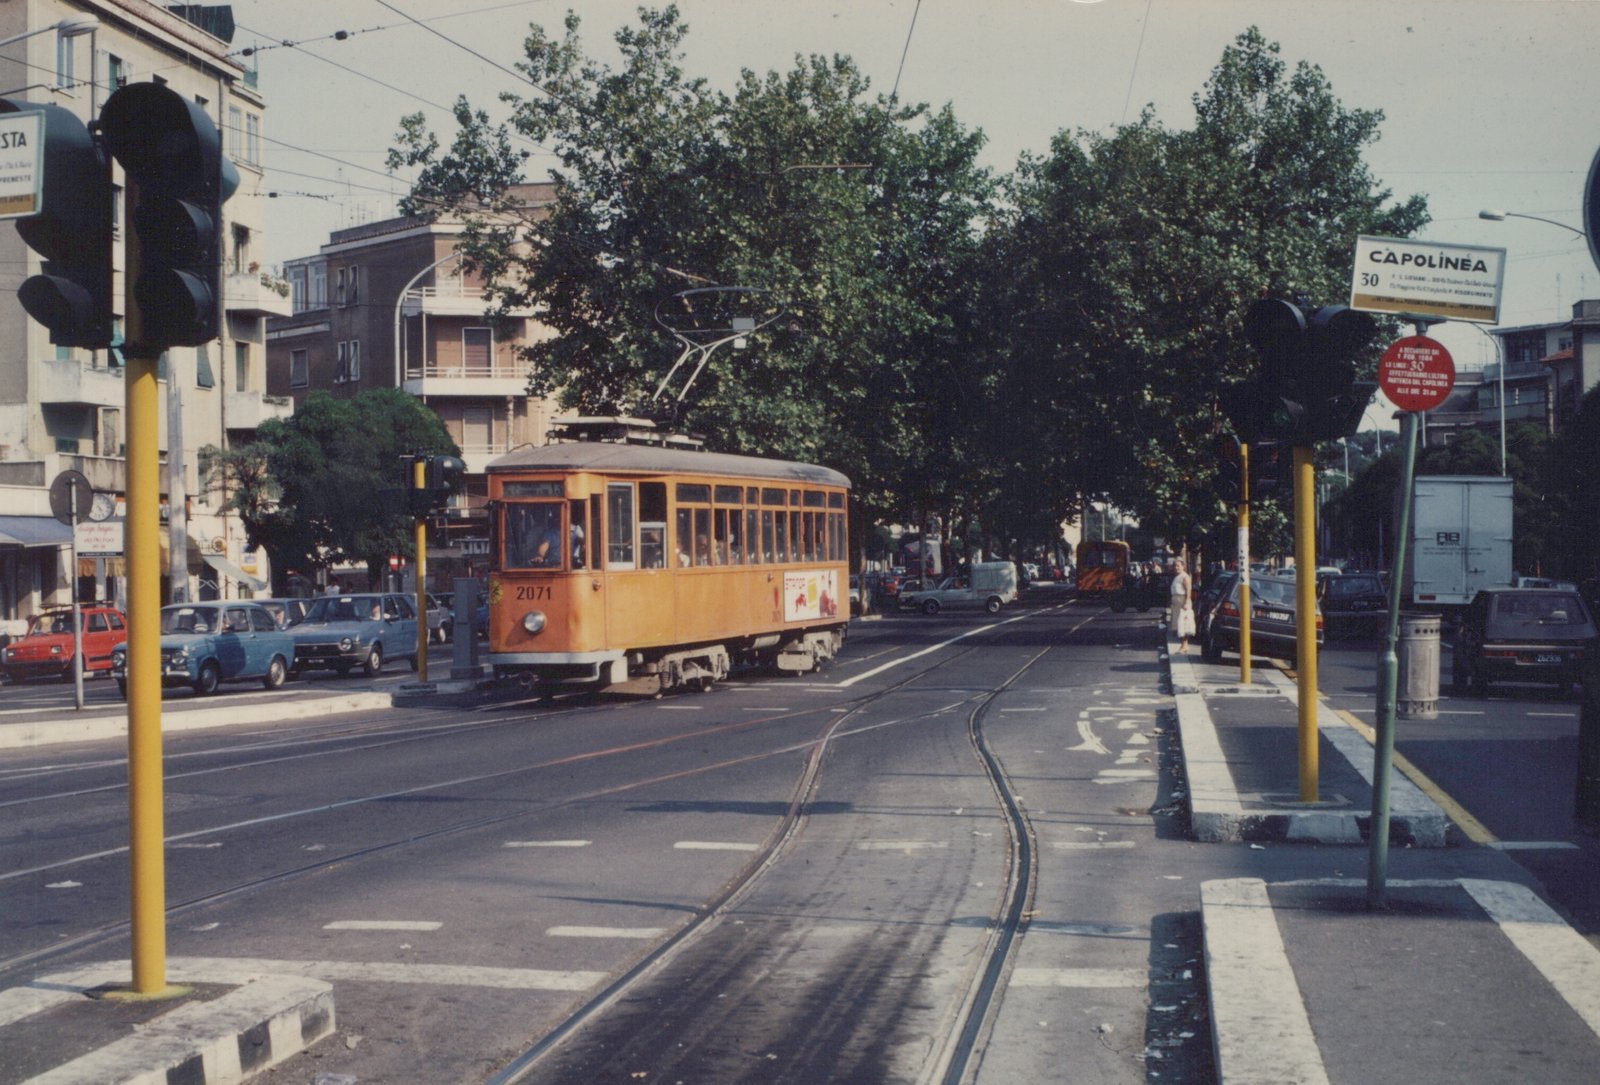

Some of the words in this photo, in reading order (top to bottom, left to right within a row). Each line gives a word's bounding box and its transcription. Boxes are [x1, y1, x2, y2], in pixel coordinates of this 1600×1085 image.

[1369, 250, 1488, 273] CAPOLINEA
[1360, 272, 1379, 287] 30
[1409, 360, 1425, 372] 30
[516, 585, 551, 601] 2071
